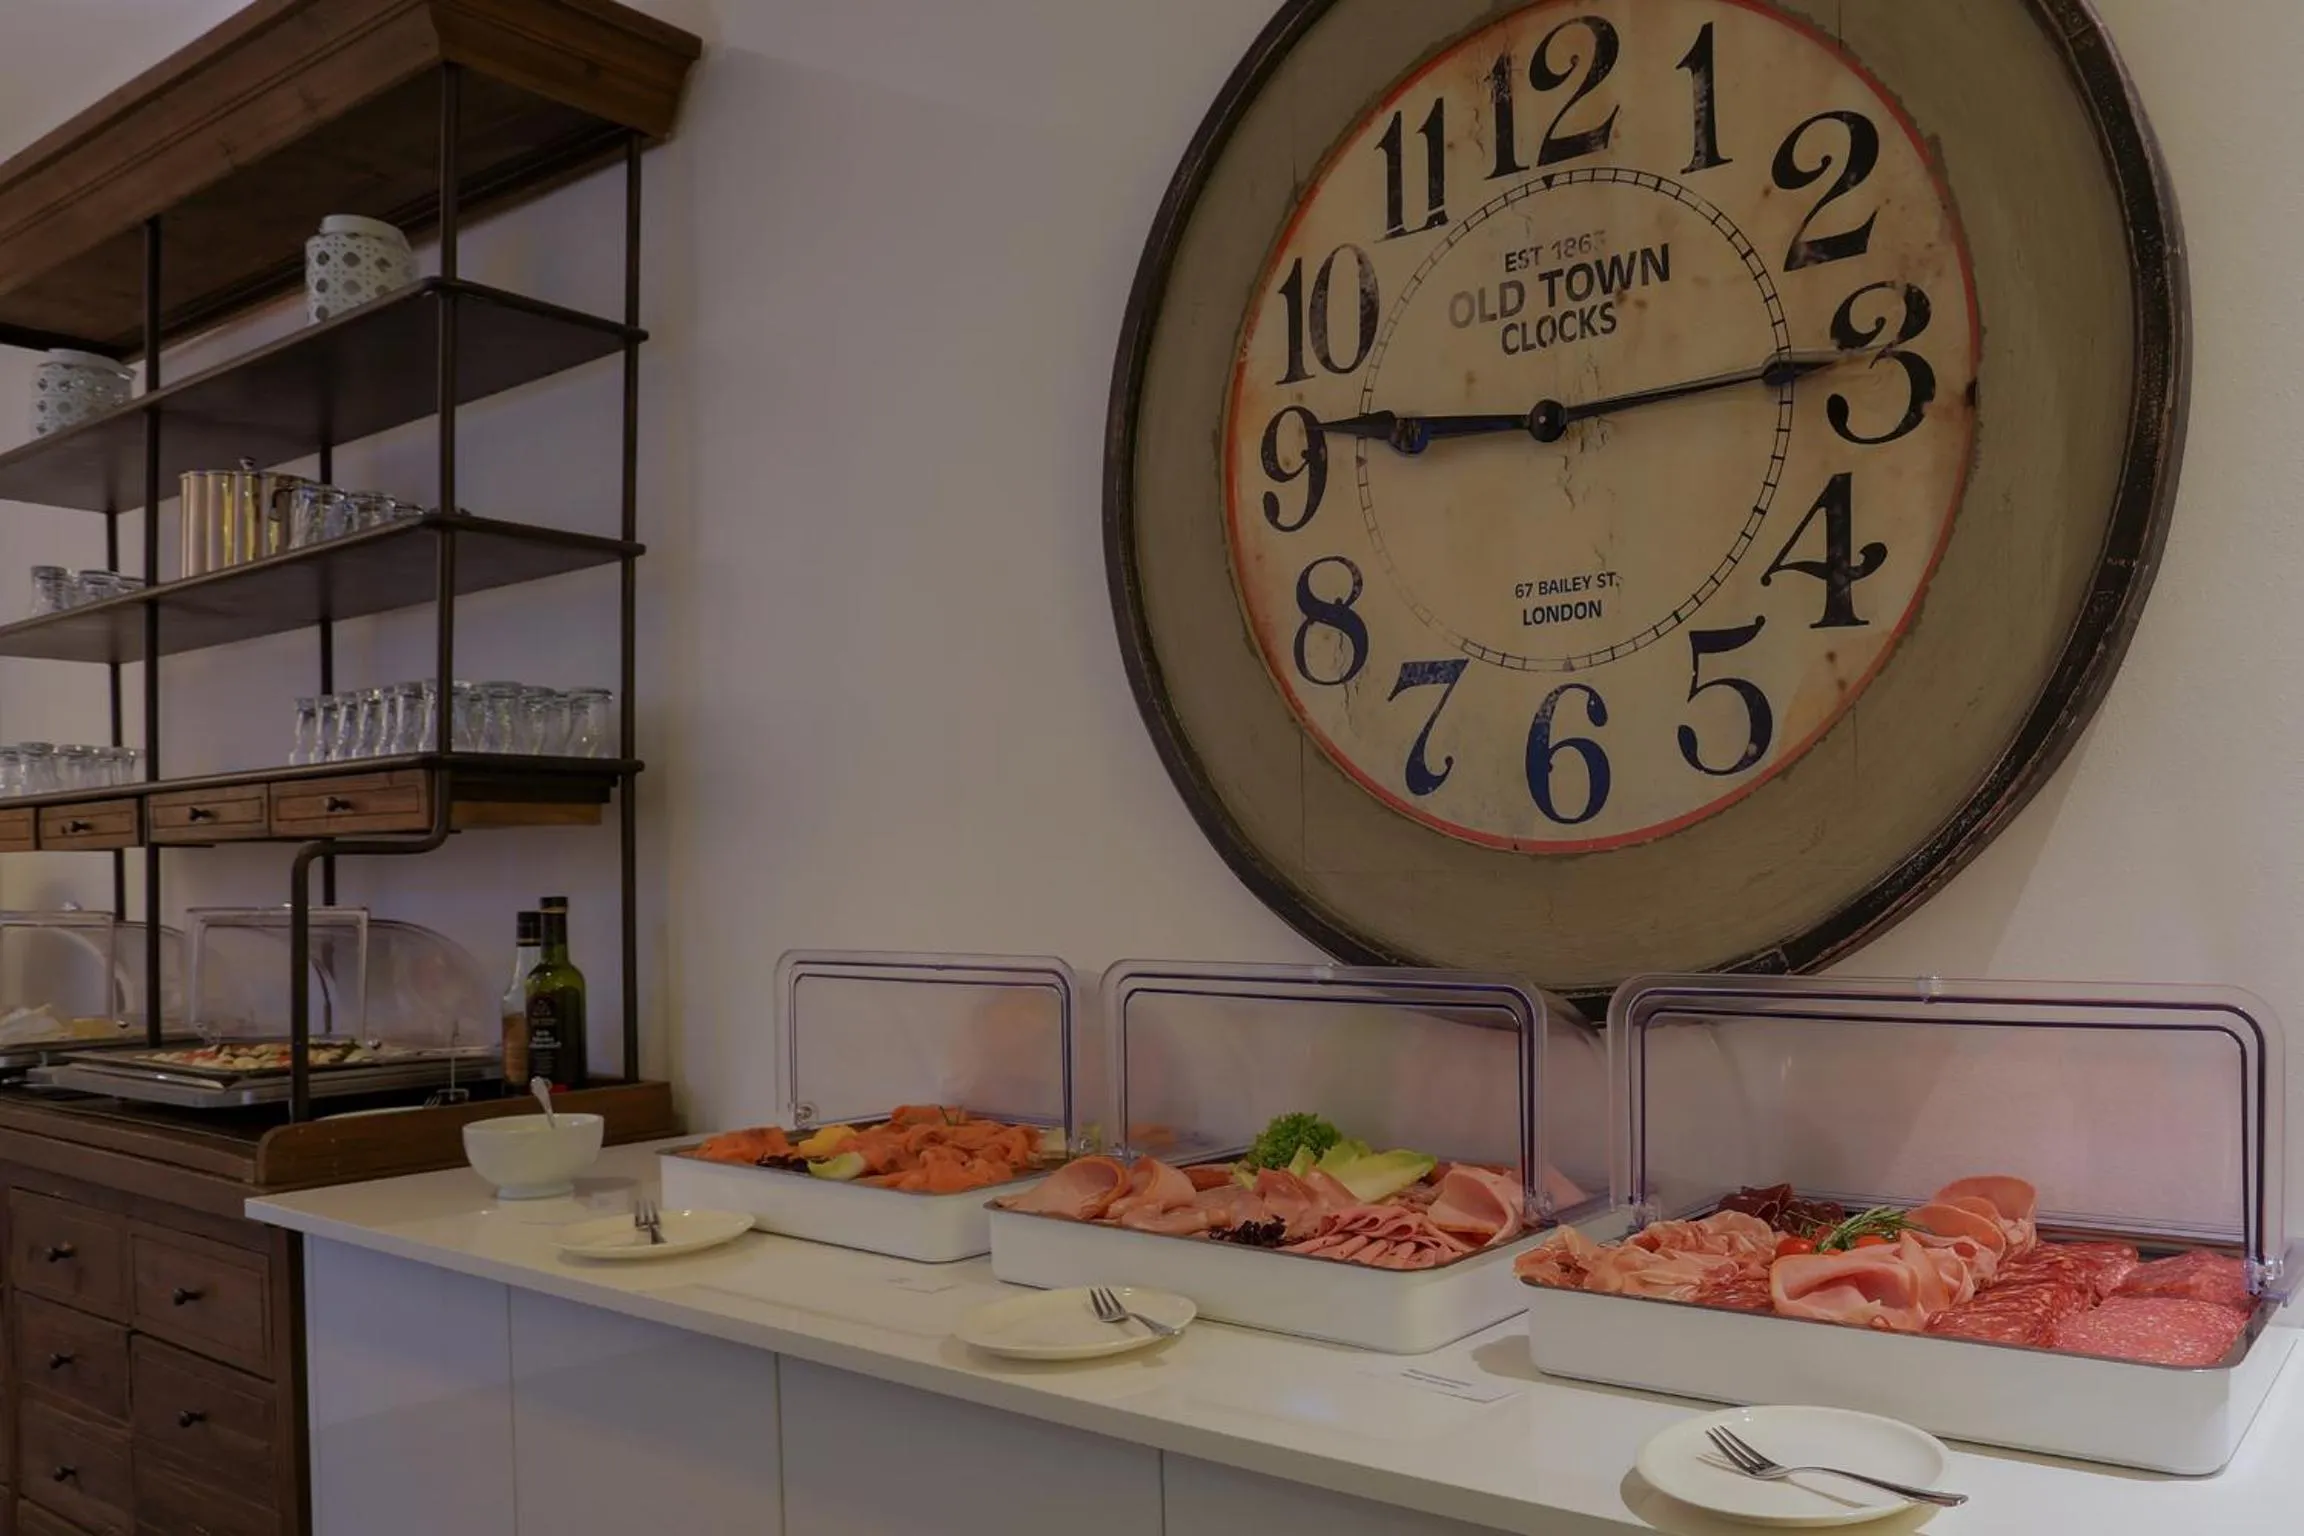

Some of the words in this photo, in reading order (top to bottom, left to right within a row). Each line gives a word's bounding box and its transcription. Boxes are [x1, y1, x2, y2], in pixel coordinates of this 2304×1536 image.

[1484, 15, 1620, 180] 12
[1676, 21, 1733, 174] 1
[1374, 97, 1449, 243] 11
[1771, 110, 1880, 272] 2
[1275, 243, 1380, 385] 10
[1450, 279, 1526, 328] OLD
[1538, 243, 1671, 308] TOWN
[1502, 301, 1617, 355] CLOCKS
[1505, 245, 1544, 273] EST
[1826, 281, 1936, 444] 3
[1260, 405, 1328, 532] 9
[1294, 556, 1368, 685] 8
[1514, 582, 1534, 599] 67
[1538, 576, 1593, 596] BAILEY
[1522, 599, 1603, 626] LONDON
[1760, 472, 1888, 628] 4
[1387, 659, 1469, 796] 7
[1525, 683, 1611, 824] 6
[1677, 615, 1773, 776] 5
